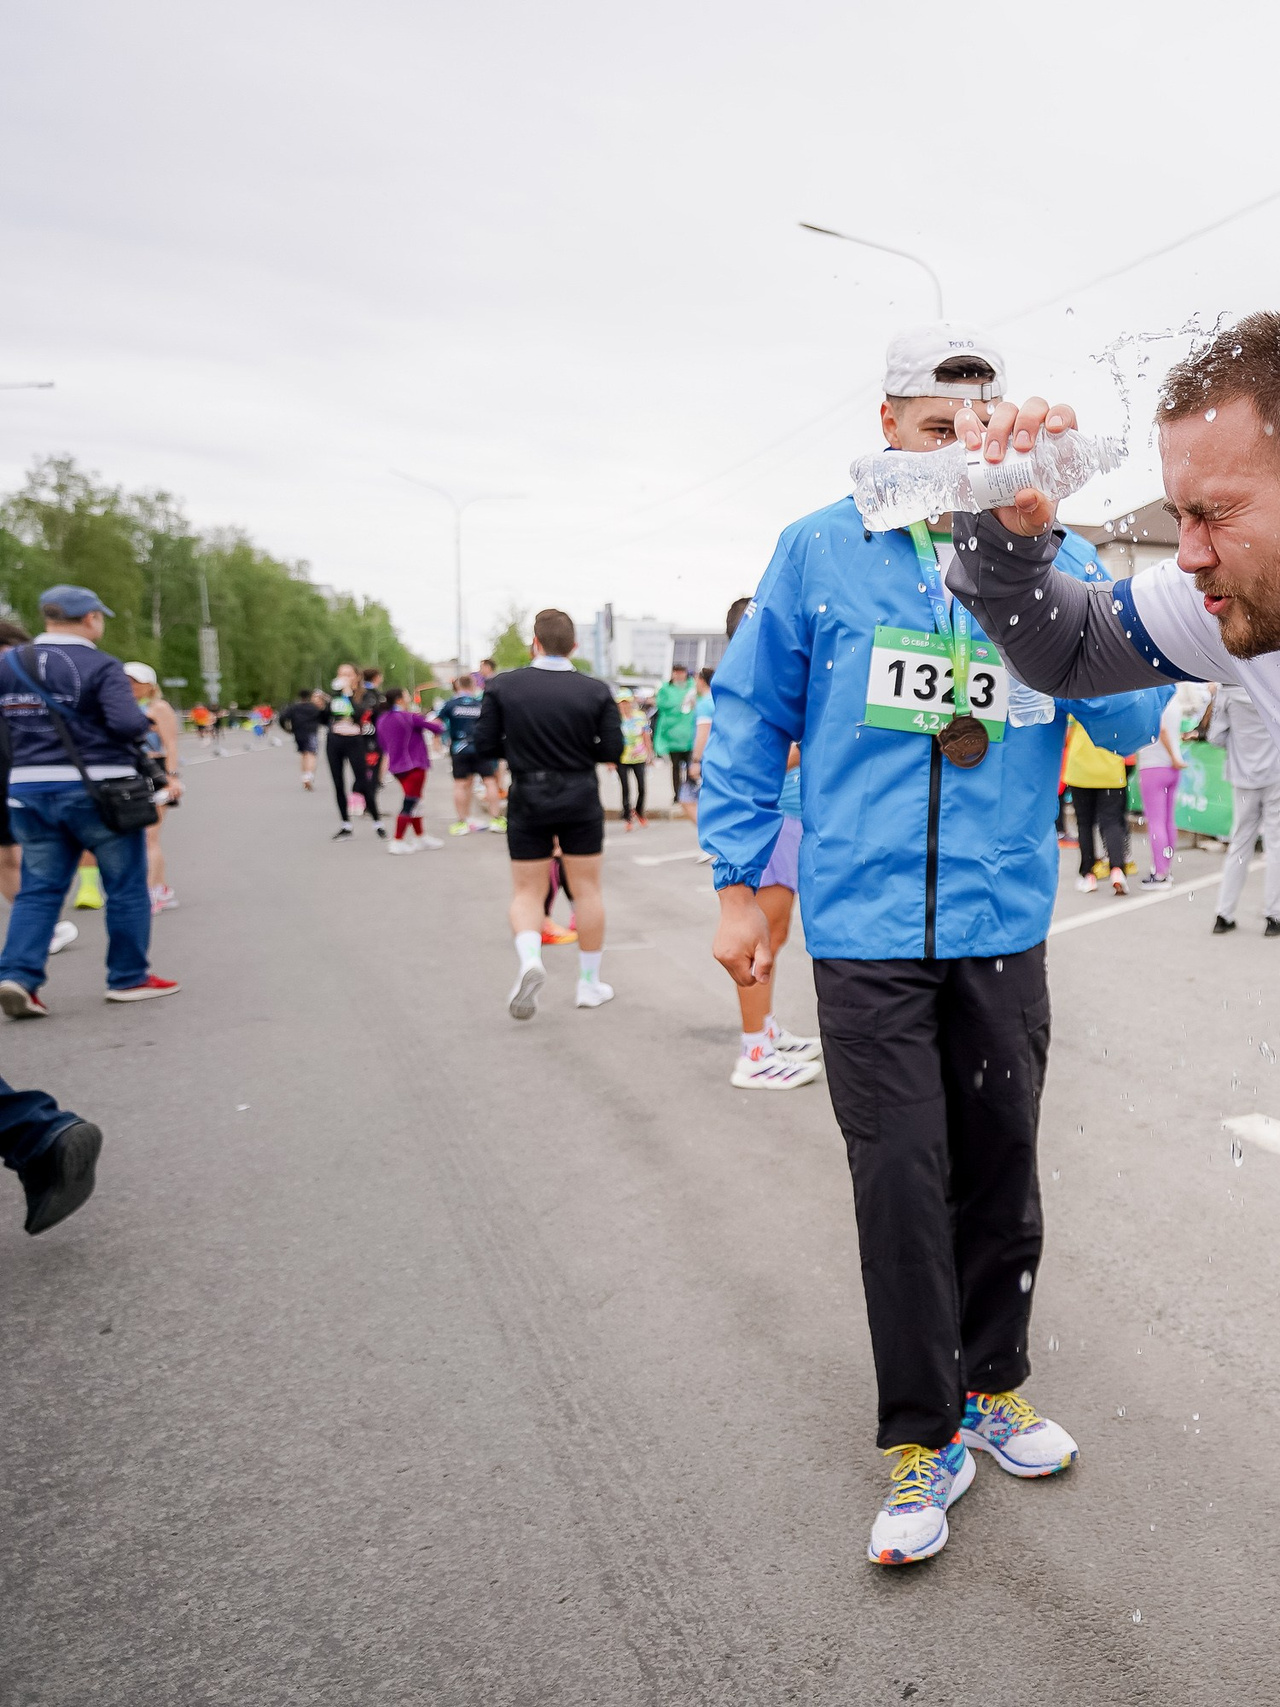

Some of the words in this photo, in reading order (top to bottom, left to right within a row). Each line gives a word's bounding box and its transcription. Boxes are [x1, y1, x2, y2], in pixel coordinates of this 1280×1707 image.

[948, 340, 975, 349] POLO
[958, 614, 968, 636] СБЕР
[911, 639, 930, 648] СБЕР
[887, 659, 996, 709] 1323
